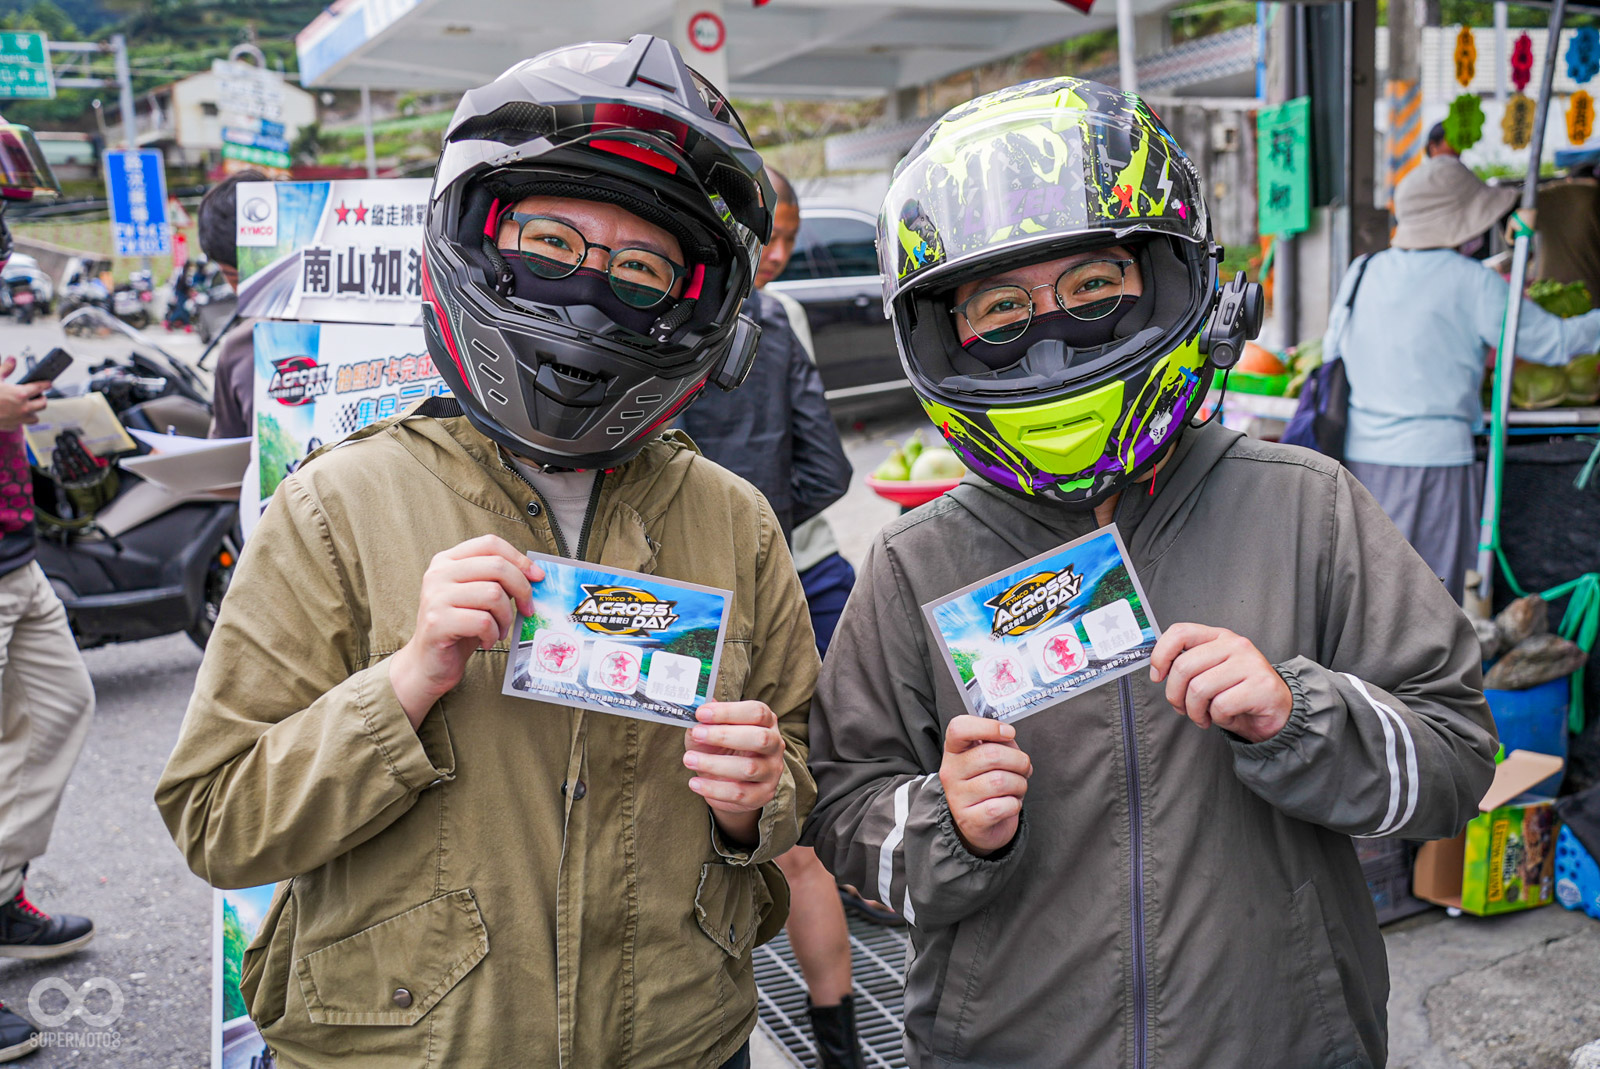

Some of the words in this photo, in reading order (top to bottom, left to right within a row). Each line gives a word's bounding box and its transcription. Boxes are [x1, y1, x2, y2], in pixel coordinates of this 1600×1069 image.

[240, 226, 273, 236] KYMCO
[336, 353, 440, 393] 拍照打卡完成
[305, 380, 331, 397] DAY
[996, 570, 1072, 628] ACROSS
[1006, 589, 1029, 607] KYMCO
[1046, 578, 1080, 610] DAY
[578, 599, 670, 616] ACROSS
[631, 616, 673, 629] DAY
